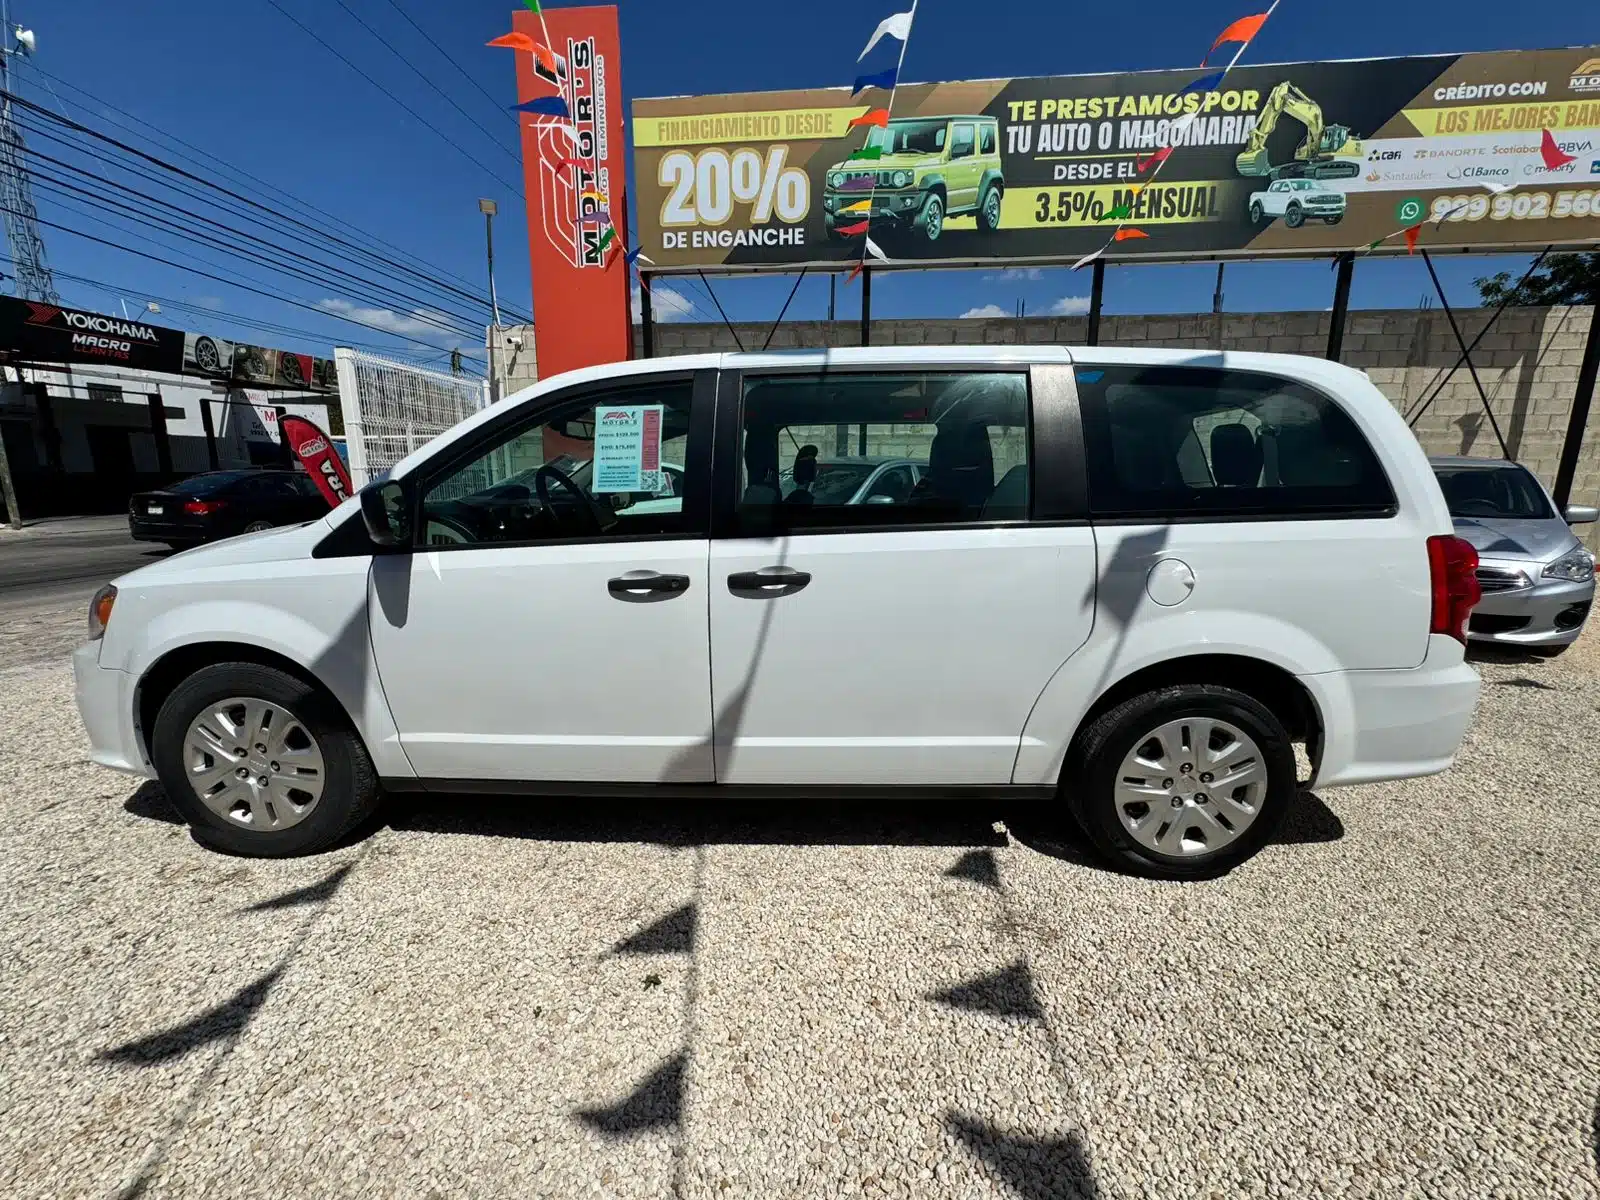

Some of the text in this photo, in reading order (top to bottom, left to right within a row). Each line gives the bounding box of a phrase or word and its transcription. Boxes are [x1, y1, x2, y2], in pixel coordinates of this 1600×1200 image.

[1007, 90, 1260, 121] TE PRESTAMOS POR
[1434, 81, 1548, 101] CRÉDITO CON
[596, 55, 607, 160] SEMINUEVOS
[1434, 111, 1470, 134] LOS
[1474, 105, 1560, 132] MEJORES
[657, 112, 833, 141] FINANCIAMIENTO DESDE
[1007, 115, 1256, 154] TU AUTO O MAQUINARIA
[1429, 148, 1486, 158] BANORTE
[1054, 161, 1137, 180] DESDE EL
[657, 144, 811, 227] 20%
[1034, 186, 1220, 223] 3.5% MENSUAL
[1489, 192, 1552, 221] 902
[662, 228, 805, 249] DE ENGANCHE
[61, 311, 157, 342] YOKOHAMA
[71, 333, 132, 352] MACRO
[73, 345, 131, 361] LLANTAS
